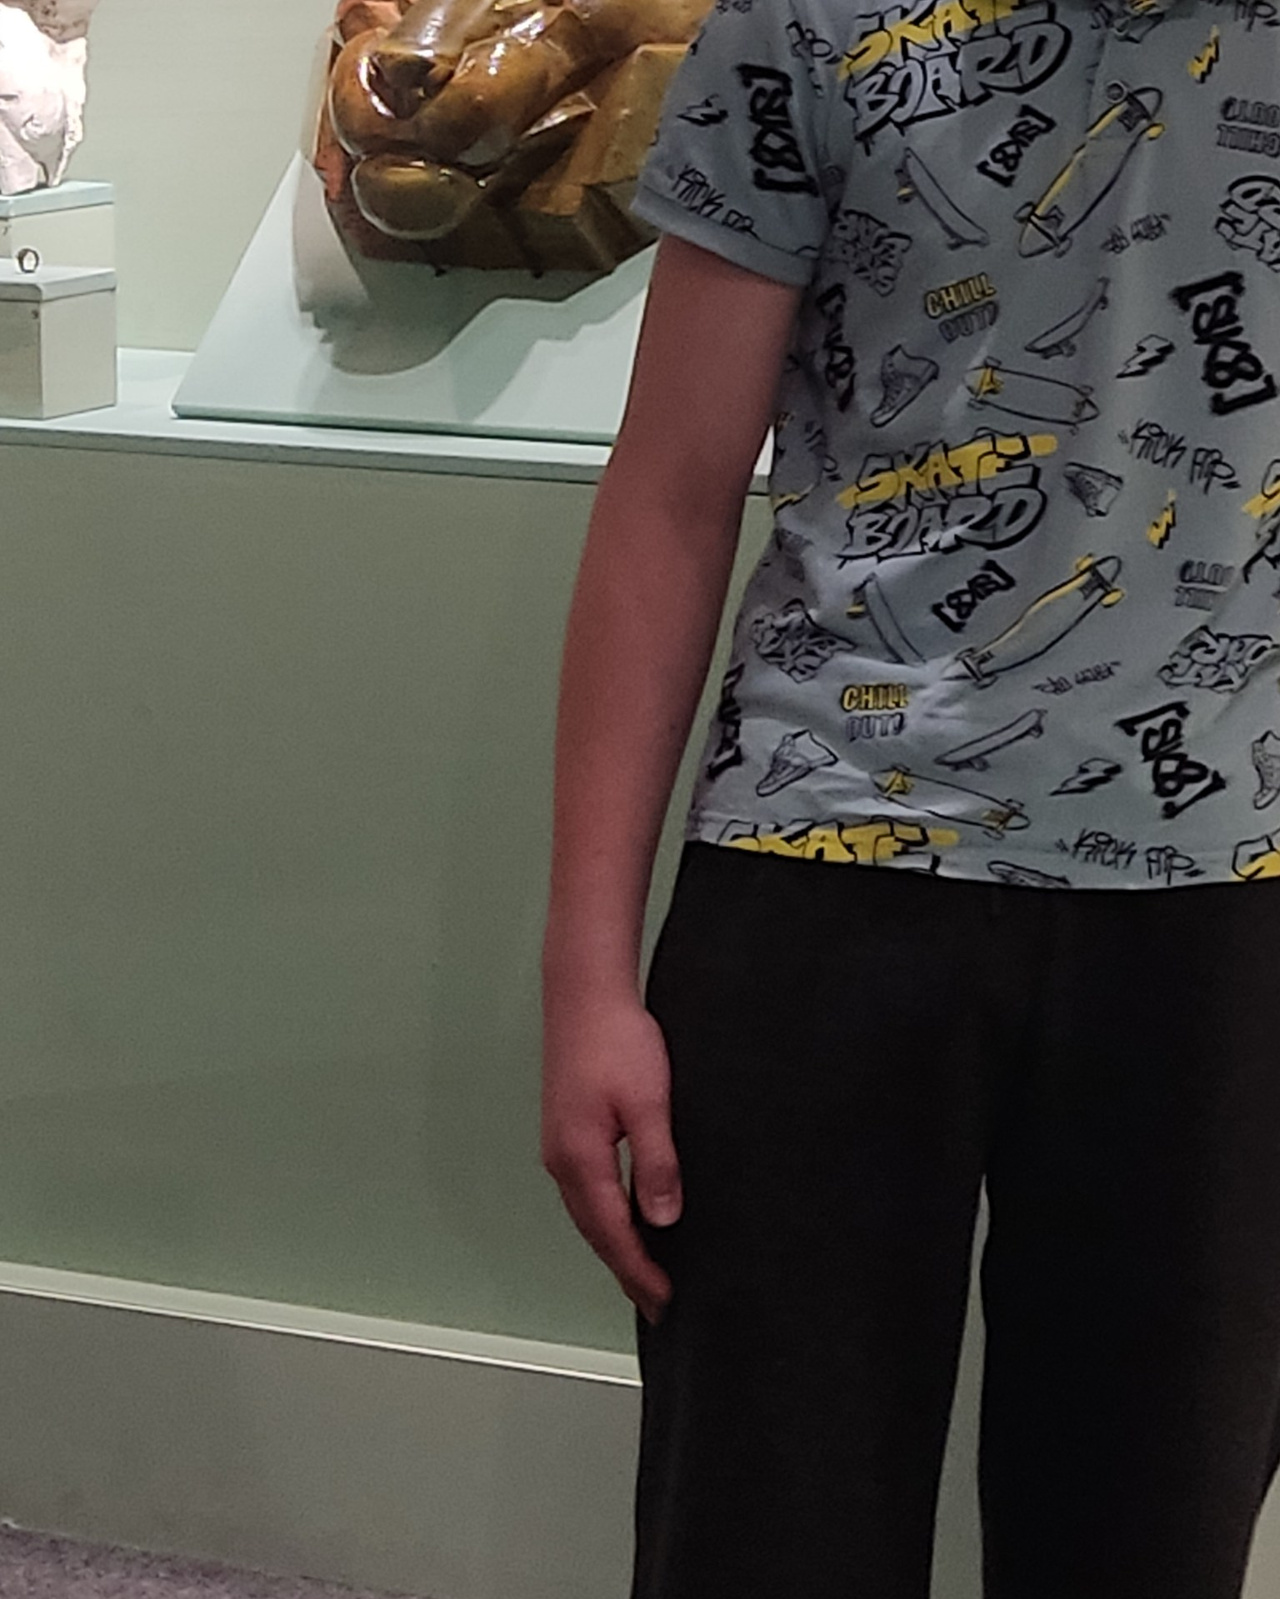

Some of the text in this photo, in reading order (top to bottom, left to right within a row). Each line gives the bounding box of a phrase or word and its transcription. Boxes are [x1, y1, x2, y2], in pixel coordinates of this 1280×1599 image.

[845, 22, 1072, 142] BOARD
[922, 271, 999, 320] CHILL
[854, 428, 1042, 510] SKATE
[838, 487, 1047, 567] BOARD
[840, 682, 912, 714] CHILL
